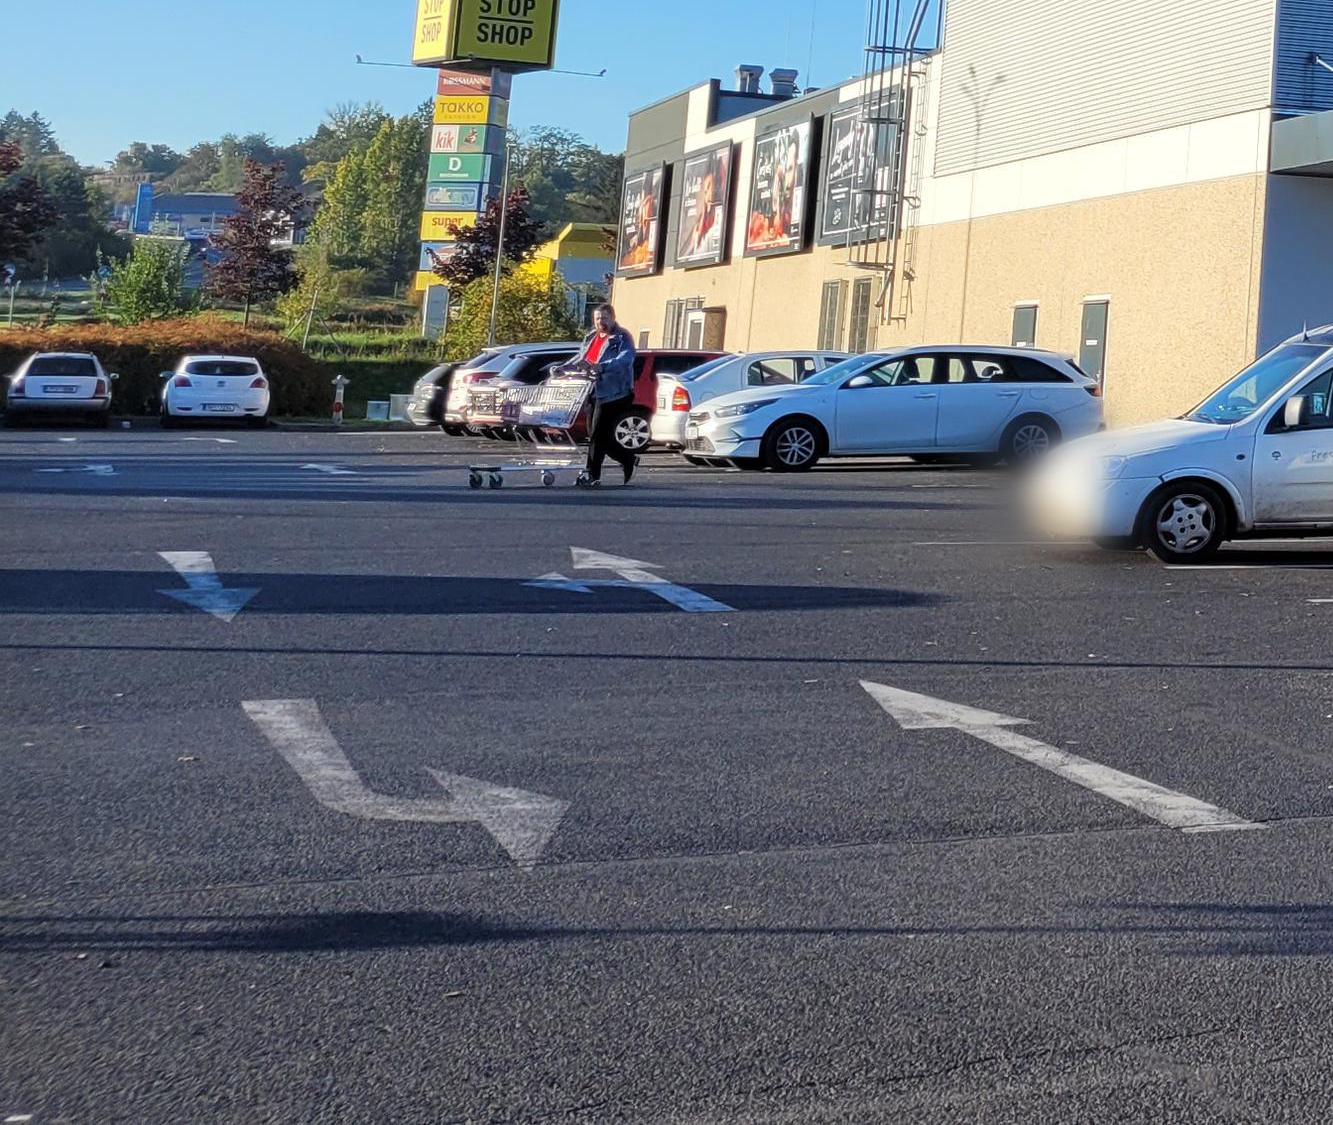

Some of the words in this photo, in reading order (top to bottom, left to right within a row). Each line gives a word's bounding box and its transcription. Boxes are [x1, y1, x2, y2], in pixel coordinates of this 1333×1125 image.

[421, 21, 441, 44] SHOP
[476, 22, 533, 46] SHOP
[431, 217, 464, 228] super
